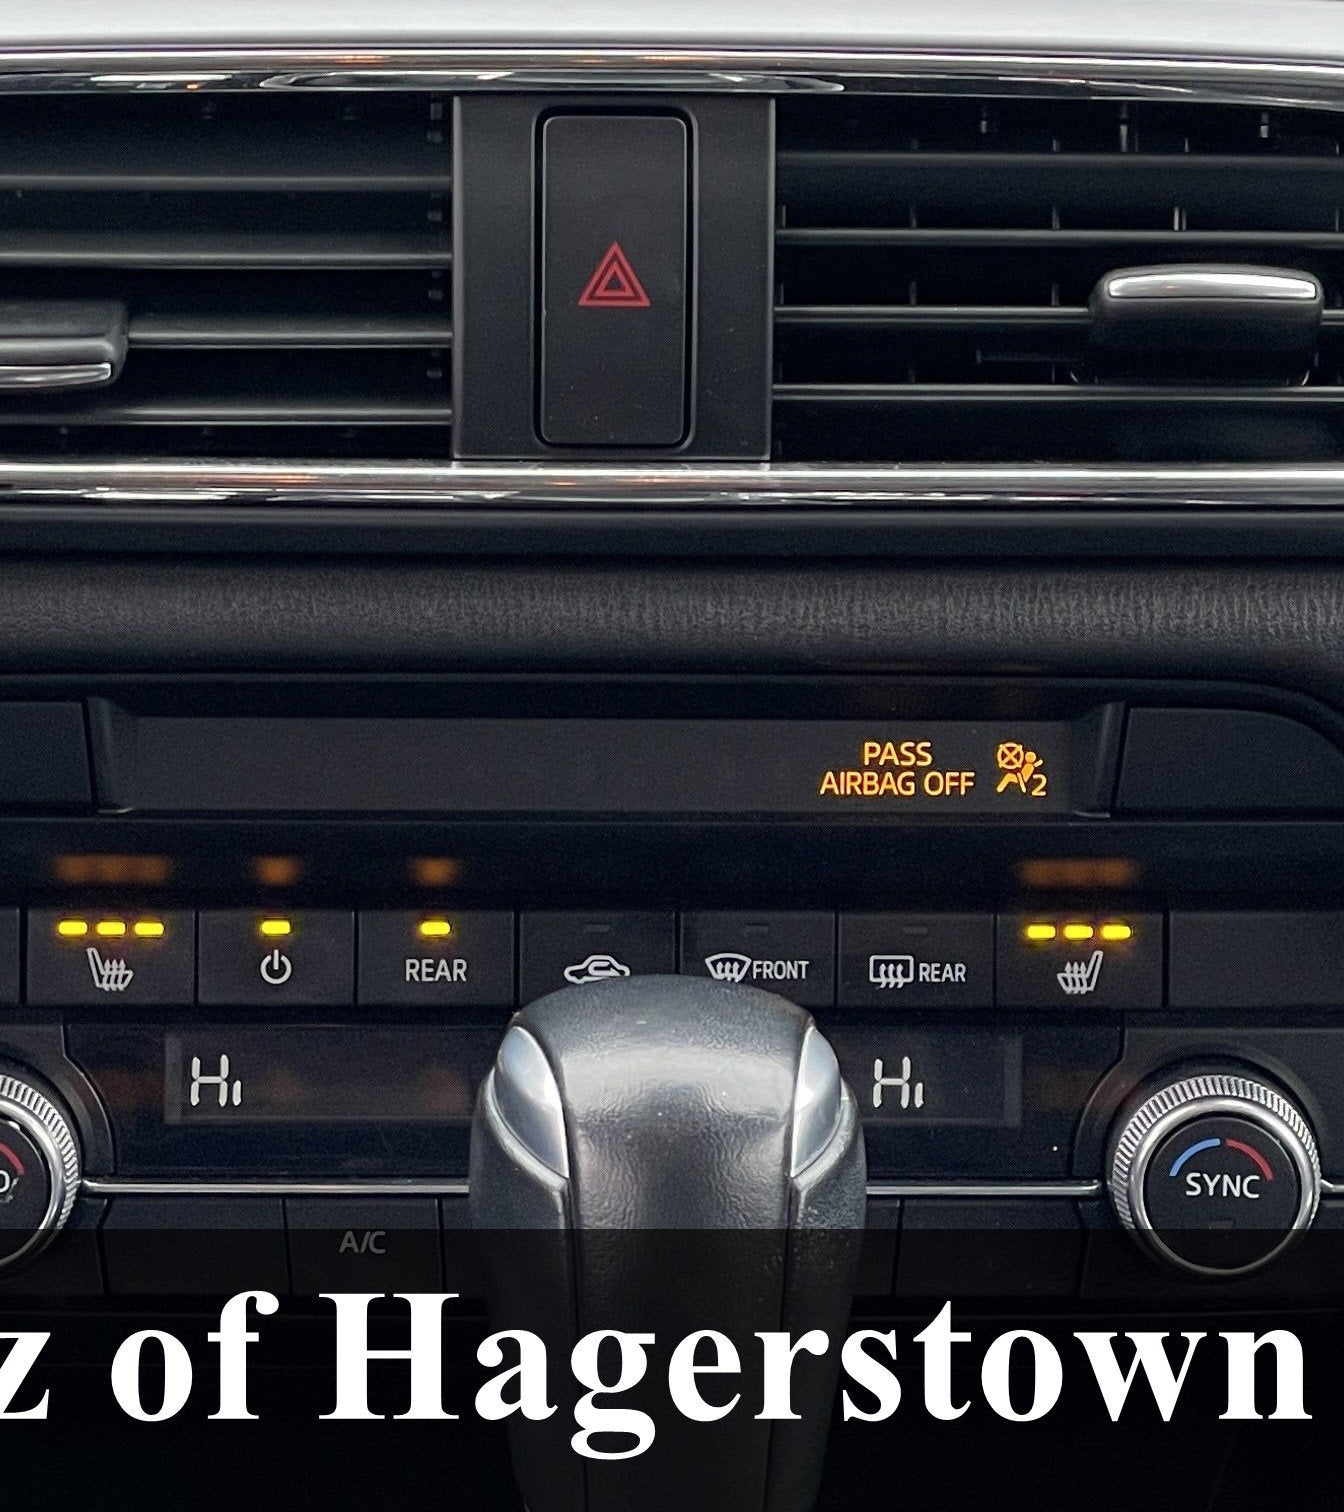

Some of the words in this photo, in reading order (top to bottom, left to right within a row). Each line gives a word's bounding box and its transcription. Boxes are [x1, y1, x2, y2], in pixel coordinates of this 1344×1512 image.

[863, 741, 933, 766] PASS
[819, 771, 916, 796] AIRBAG
[923, 771, 975, 796] OFF
[405, 958, 467, 982] REAR
[752, 960, 810, 981] FRONT
[919, 961, 966, 983] REAR
[1184, 1172, 1260, 1200] SYNC
[339, 1230, 387, 1255] A/C
